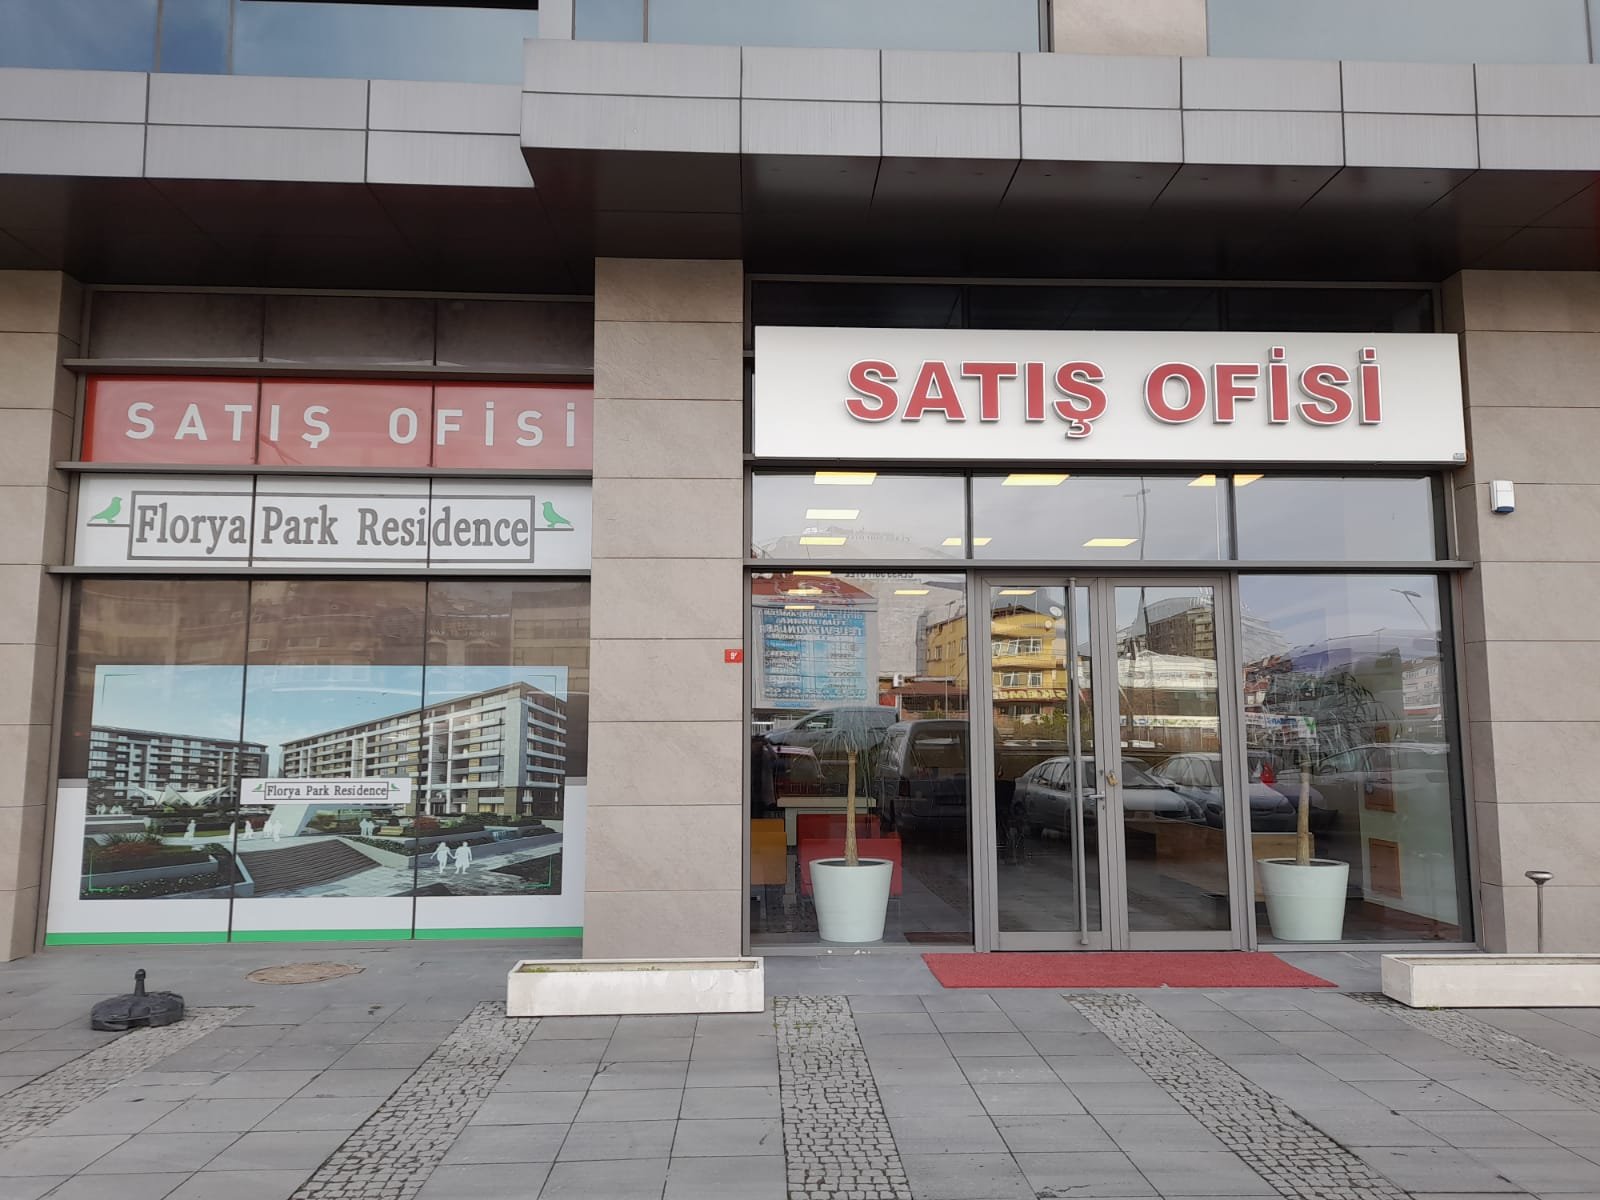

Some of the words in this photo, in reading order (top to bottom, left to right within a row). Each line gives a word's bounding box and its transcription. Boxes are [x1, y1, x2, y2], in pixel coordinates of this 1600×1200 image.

[845, 359, 1108, 439] SATIŞ
[1142, 345, 1383, 426] OFİSİ
[125, 401, 332, 449] SATIŞ
[387, 401, 578, 448] OFİSİ
[135, 502, 247, 555] Florya
[261, 504, 339, 546] Park
[357, 507, 529, 548] Residence
[267, 785, 300, 799] Florya
[306, 785, 329, 796] Park
[334, 785, 387, 796] Residence
